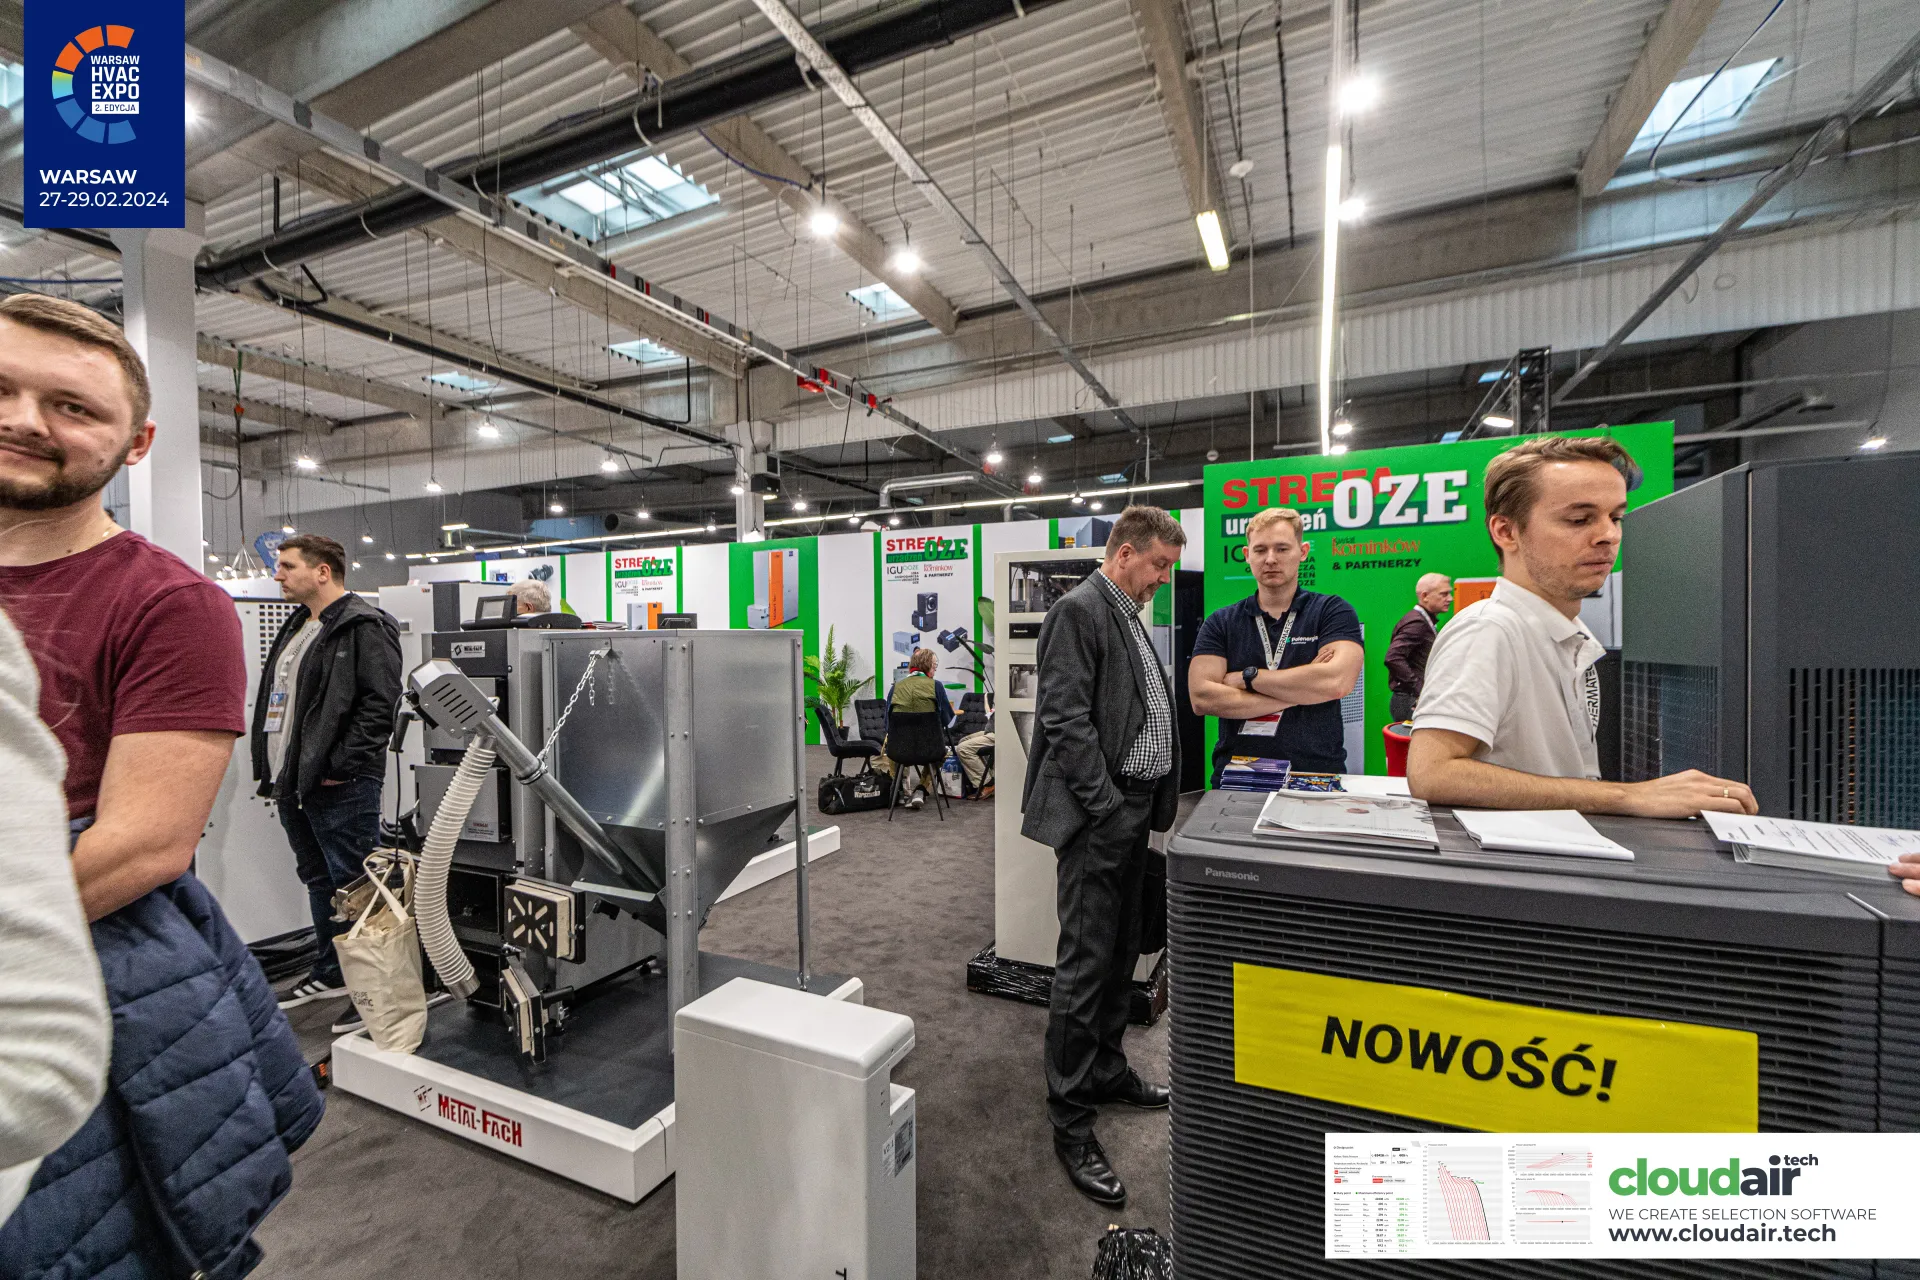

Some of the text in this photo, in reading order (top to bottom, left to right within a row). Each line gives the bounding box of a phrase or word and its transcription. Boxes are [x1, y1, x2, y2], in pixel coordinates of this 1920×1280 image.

[1333, 470, 1467, 528] OZE
[924, 538, 968, 560] OZE
[1332, 538, 1420, 556] kominków
[642, 558, 673, 577] OZE
[887, 566, 903, 575] IGU
[1332, 558, 1422, 570] & PARTNERZY
[1205, 867, 1260, 882] Panasonic
[1321, 1015, 1618, 1103] NOWOŚĆ!
[438, 1093, 522, 1147] METAL-FACH
